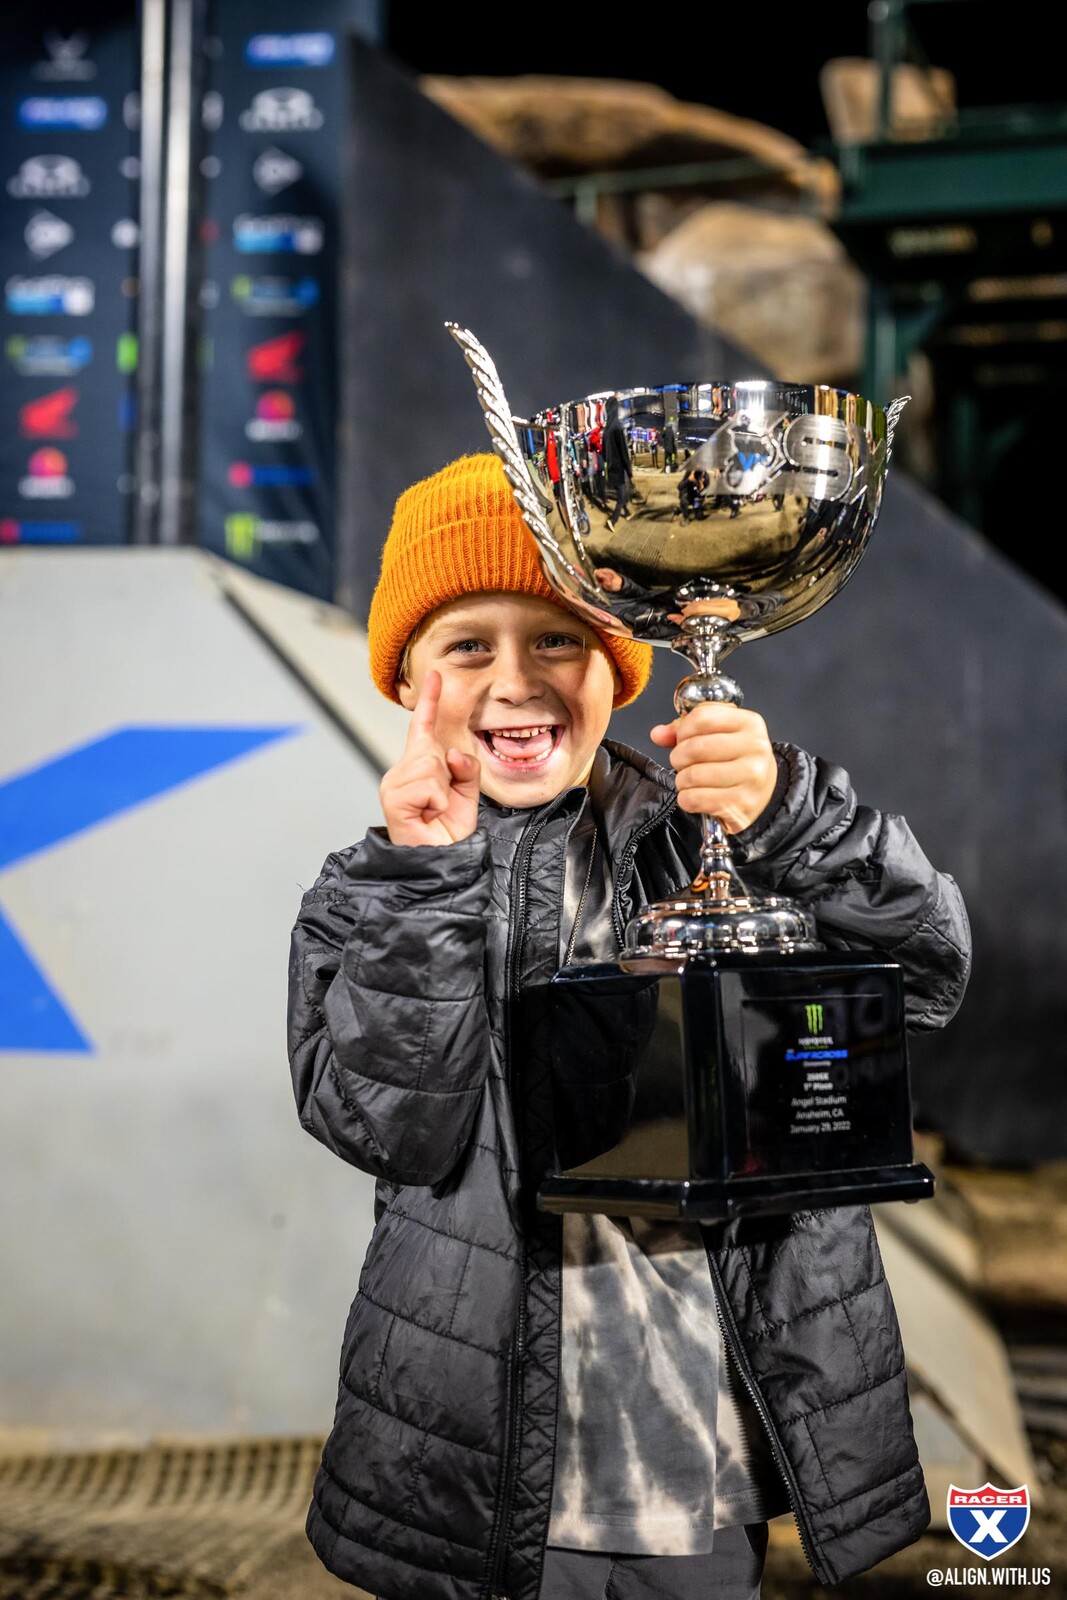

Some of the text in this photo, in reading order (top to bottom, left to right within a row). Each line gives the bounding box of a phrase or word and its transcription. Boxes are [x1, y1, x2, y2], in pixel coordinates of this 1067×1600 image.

[791, 1095, 847, 1108] Angel Stadium
[832, 1108, 845, 1118] CA
[790, 1124, 820, 1134] January
[832, 1120, 851, 1131] 2022
